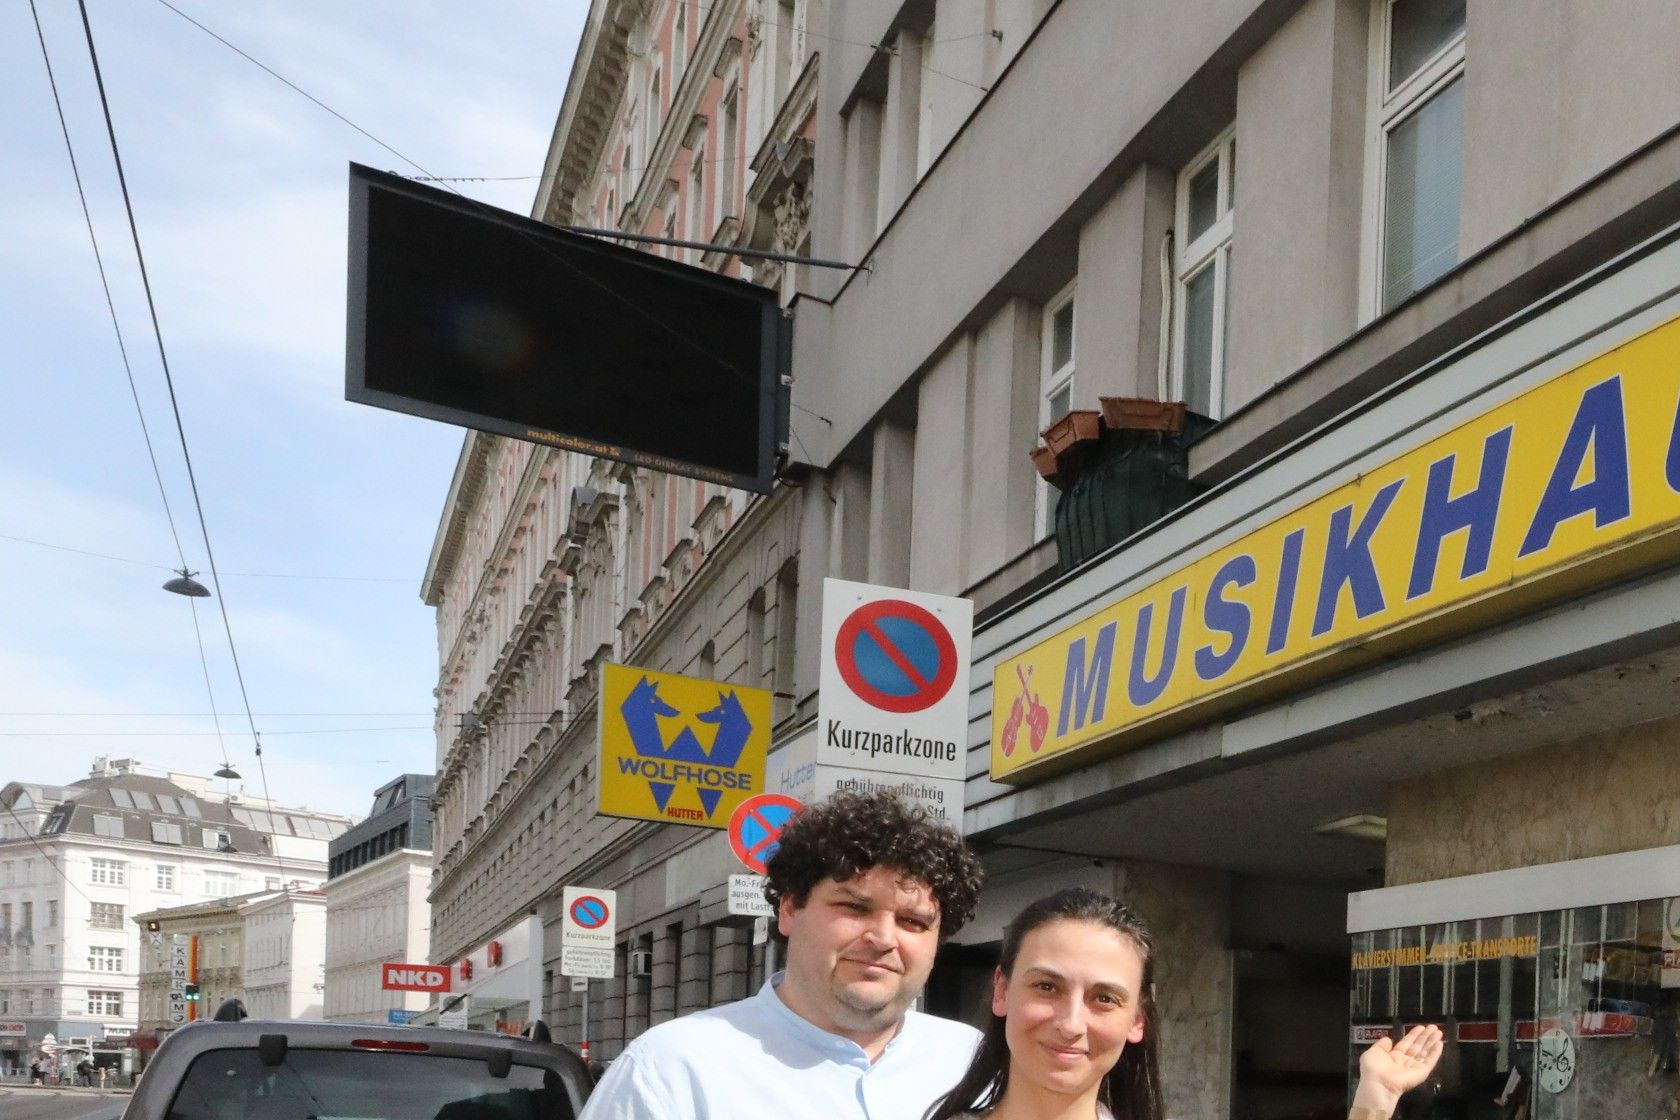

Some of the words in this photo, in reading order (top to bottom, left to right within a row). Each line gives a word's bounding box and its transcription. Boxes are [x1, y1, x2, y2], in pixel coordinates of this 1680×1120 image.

[827, 719, 957, 761] Kurzparkzone
[618, 757, 752, 790] WOLFHOSE
[667, 807, 704, 821] HUTTER
[388, 969, 444, 987] NKD
